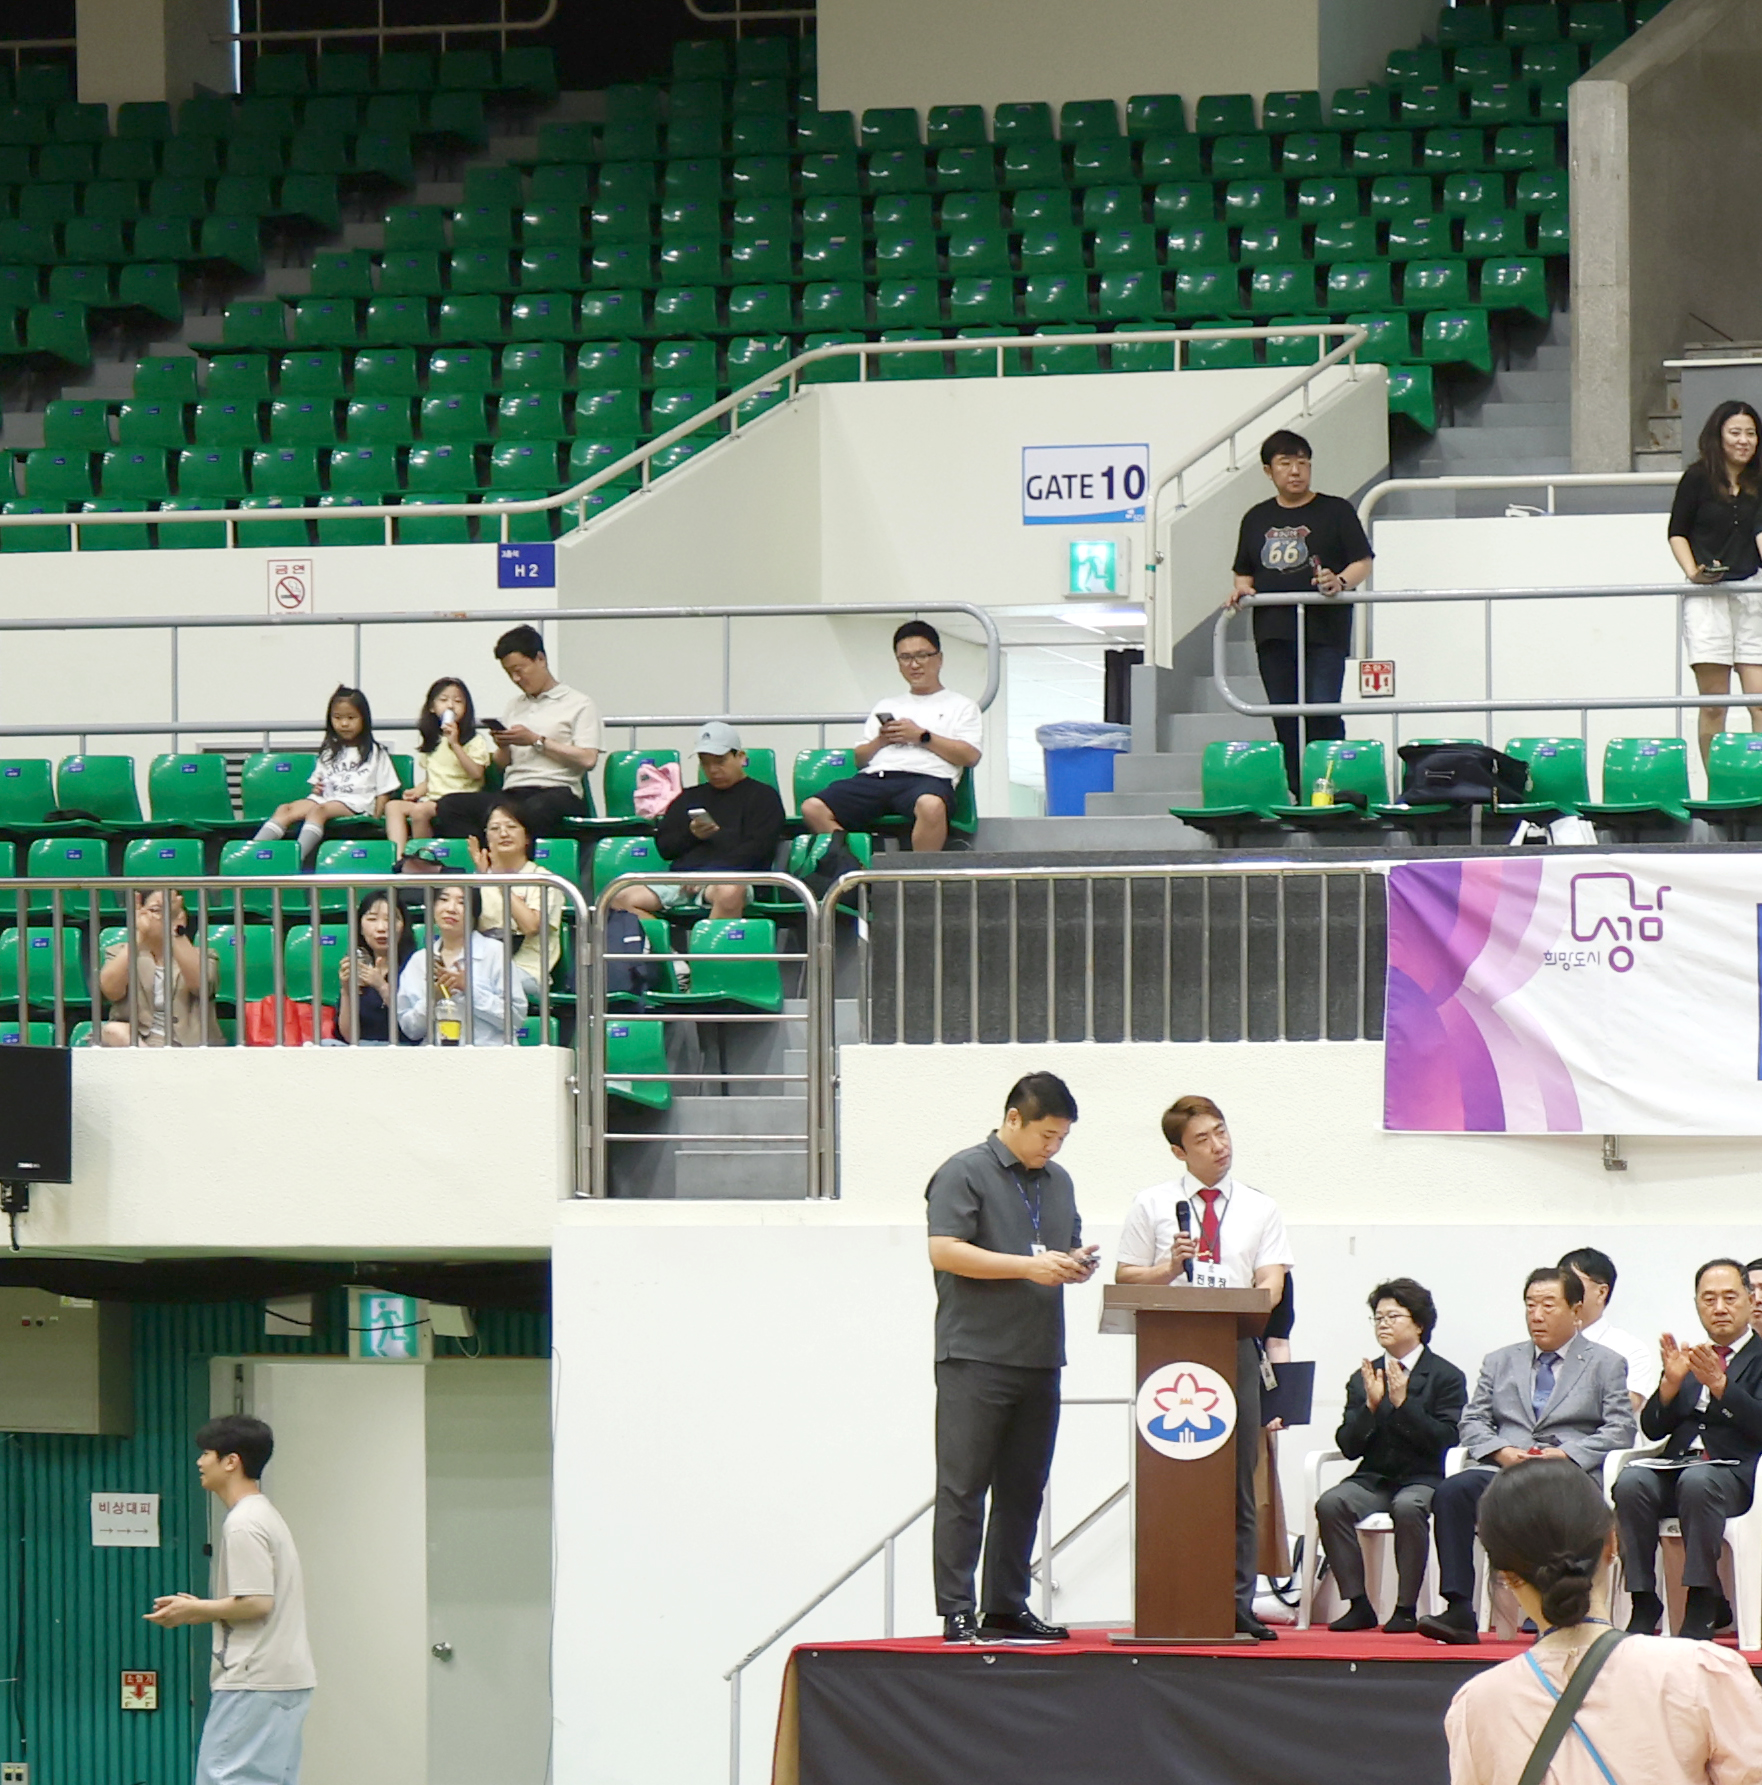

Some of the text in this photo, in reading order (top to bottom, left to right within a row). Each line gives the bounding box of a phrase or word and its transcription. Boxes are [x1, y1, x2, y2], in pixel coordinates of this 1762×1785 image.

[1026, 464, 1145, 500] GATE 10
[1268, 541, 1299, 564] 66
[514, 564, 539, 578] H 2
[98, 1501, 151, 1515] 비상대피
